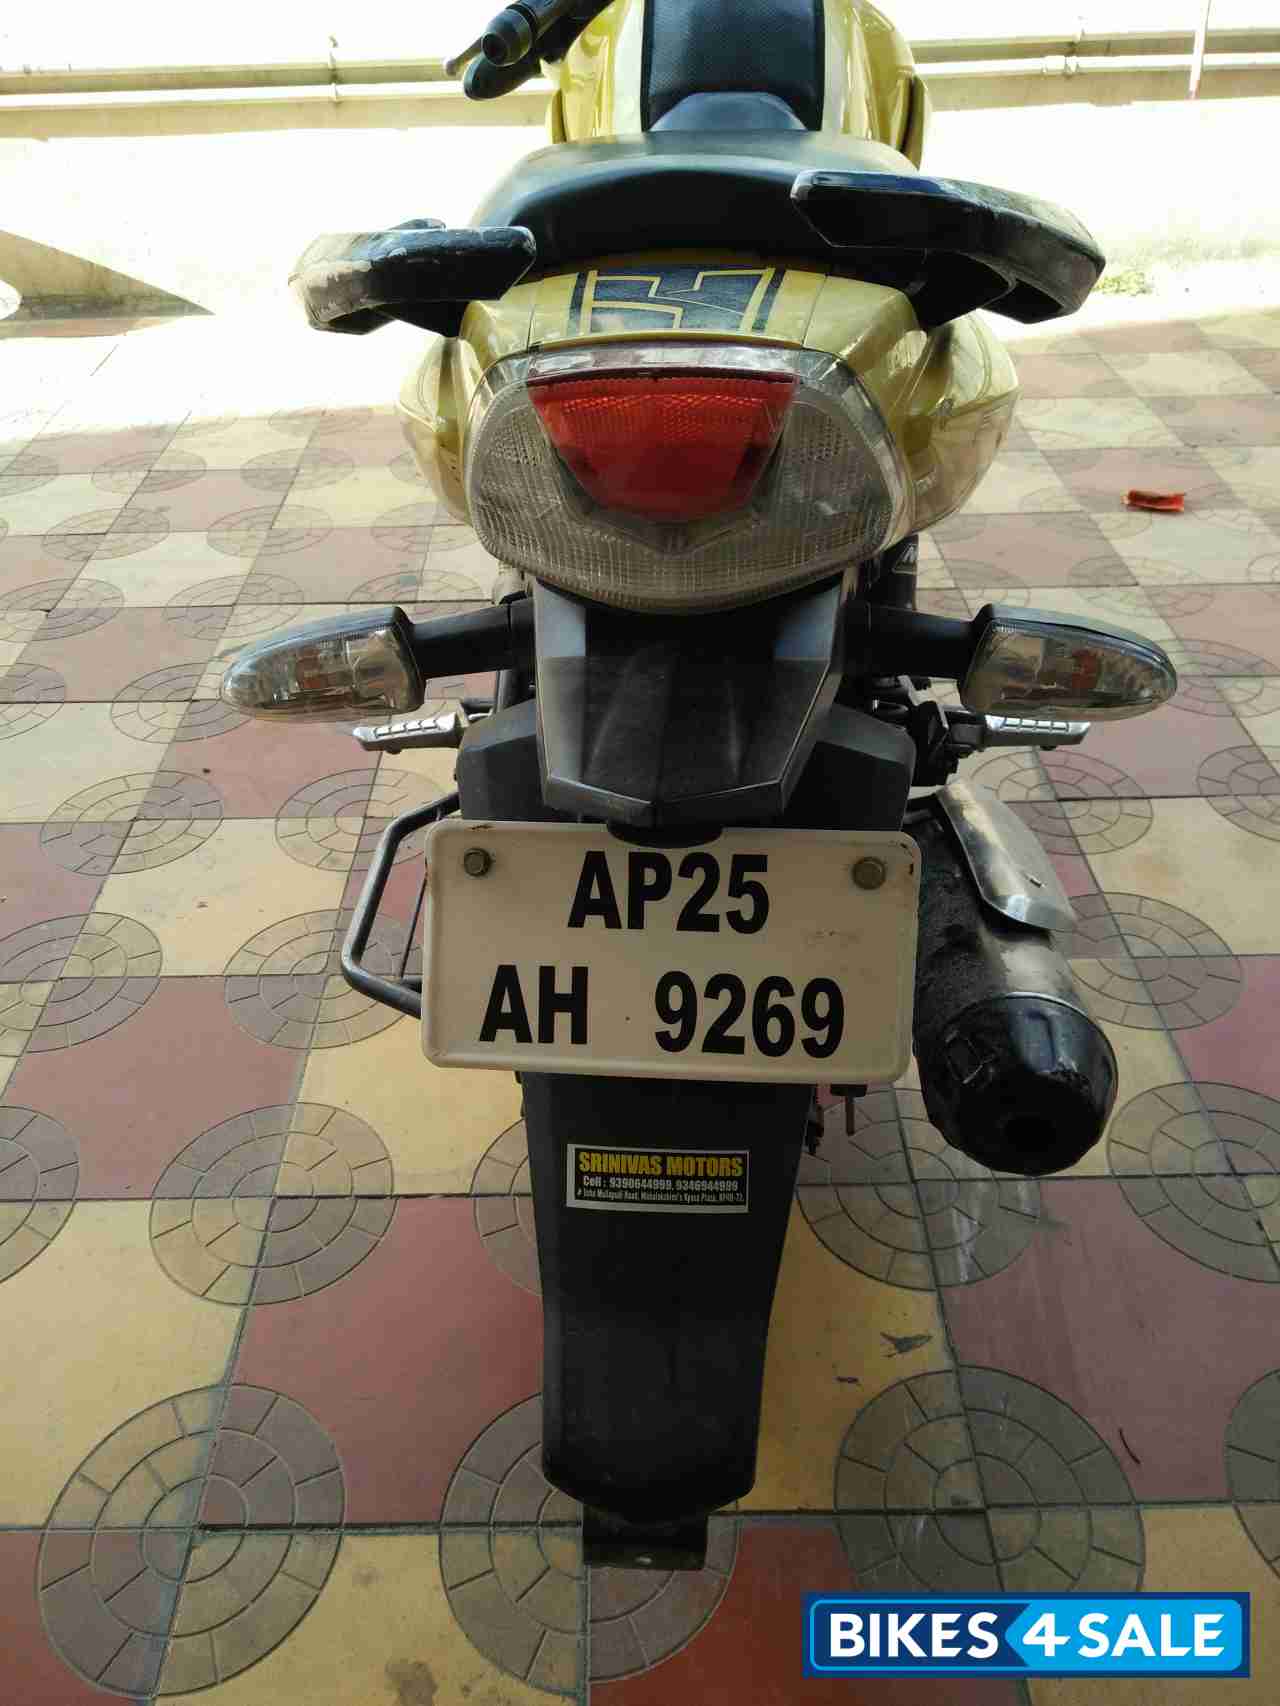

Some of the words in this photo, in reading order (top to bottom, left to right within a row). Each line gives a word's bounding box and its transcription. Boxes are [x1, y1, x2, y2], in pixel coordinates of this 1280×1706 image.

[567, 850, 770, 935] AP25
[479, 964, 589, 1046] AH
[655, 971, 845, 1059] 9269
[578, 1151, 663, 1176] SRINIVAS
[666, 1155, 744, 1177] MOTORS
